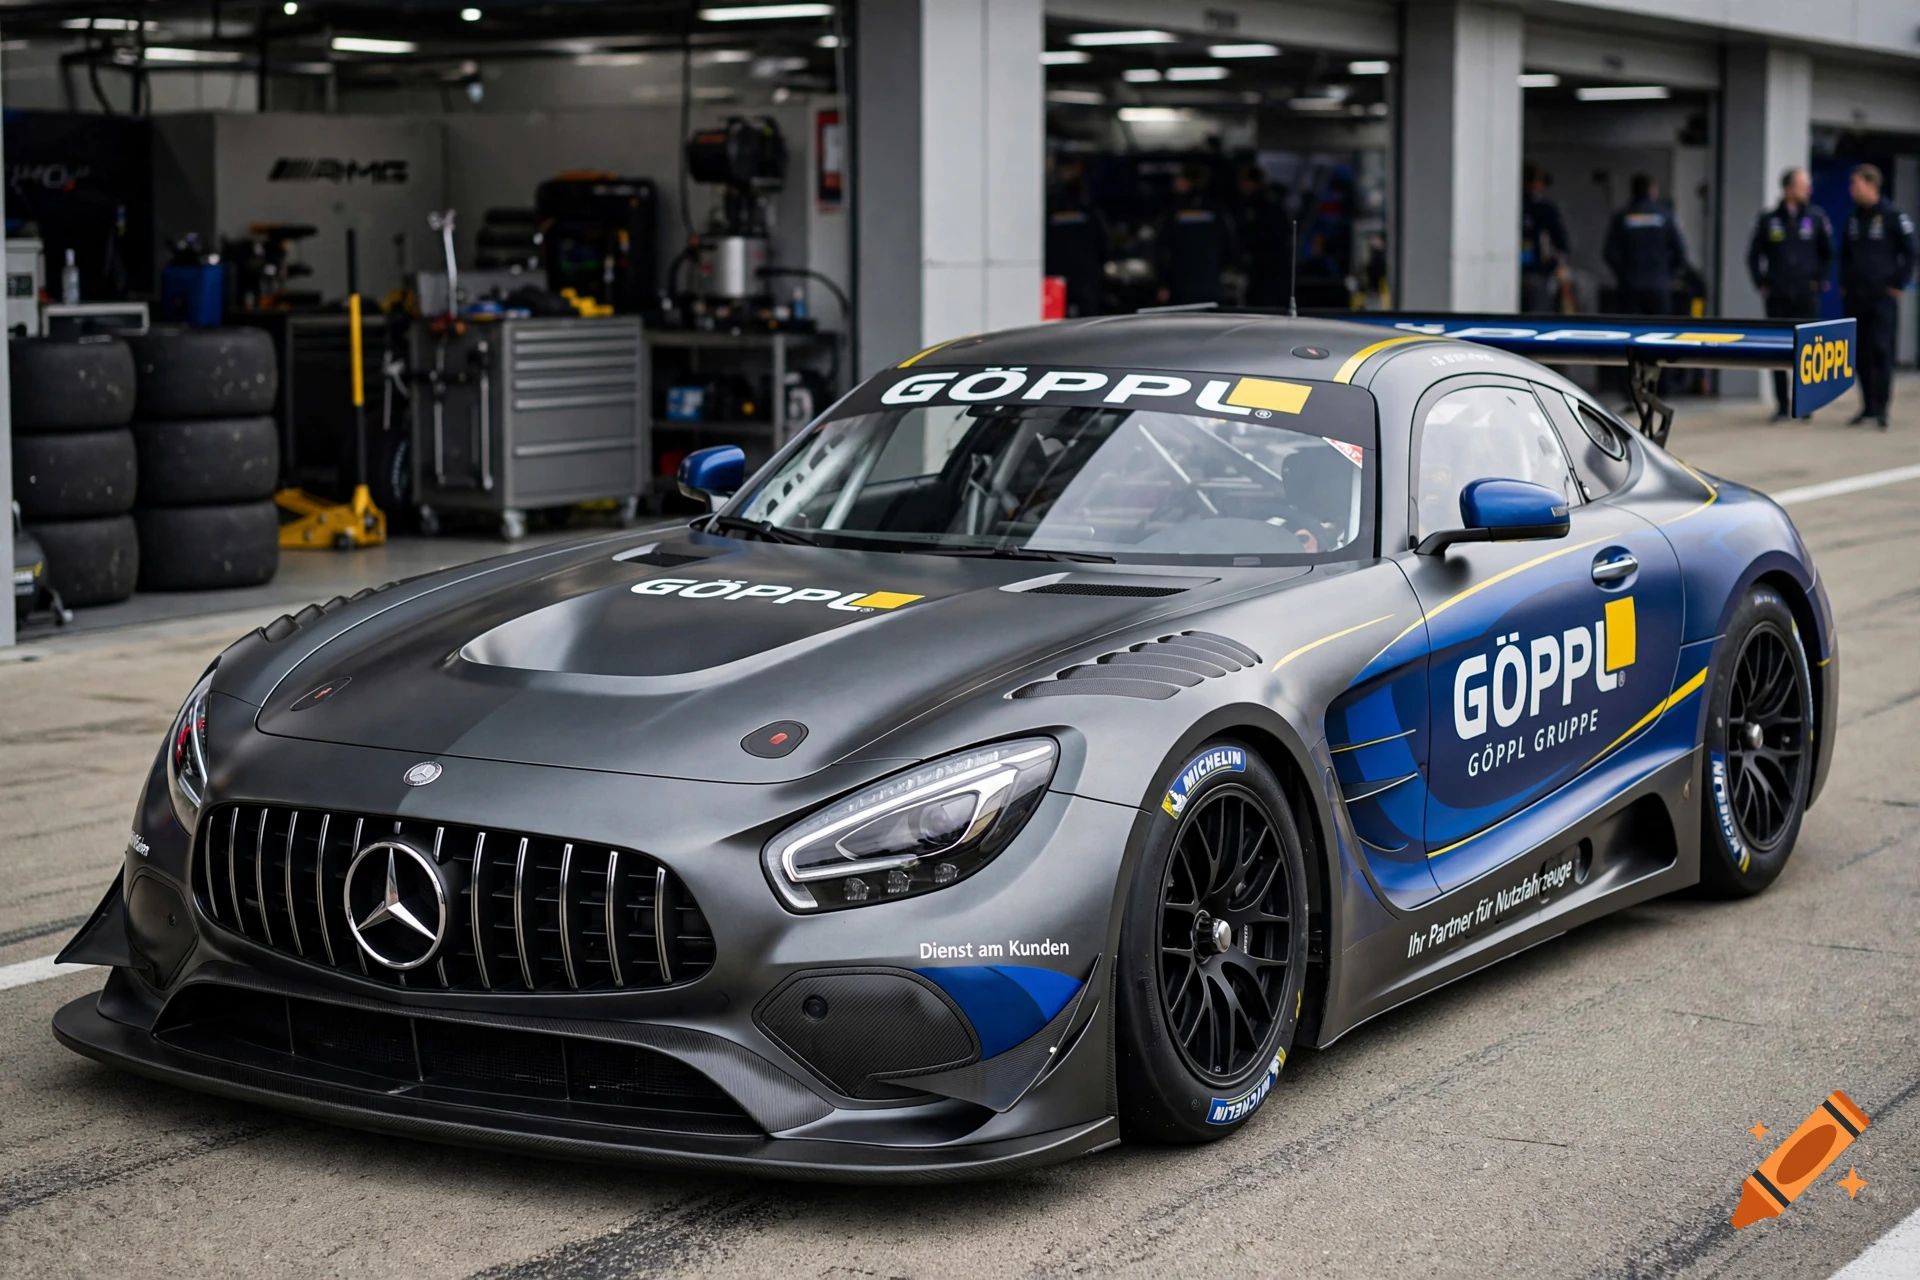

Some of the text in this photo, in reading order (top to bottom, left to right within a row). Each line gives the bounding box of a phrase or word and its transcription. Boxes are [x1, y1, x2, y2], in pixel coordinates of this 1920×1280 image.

[1800, 335, 1853, 385] GÖPPL
[881, 367, 1252, 415] GÖPPL
[630, 578, 868, 611] GÖPPL
[1454, 621, 1618, 740] GÖPPL
[1468, 708, 1598, 777] GÖPPL GRUPPE
[1182, 751, 1242, 793] MICHELIN
[920, 938, 1070, 959] Dienst am Kunden
[1407, 931, 1426, 958] Ihr
[1428, 911, 1474, 948] Partner
[1475, 897, 1494, 926] für
[1213, 1075, 1271, 1121] MICHELIN
